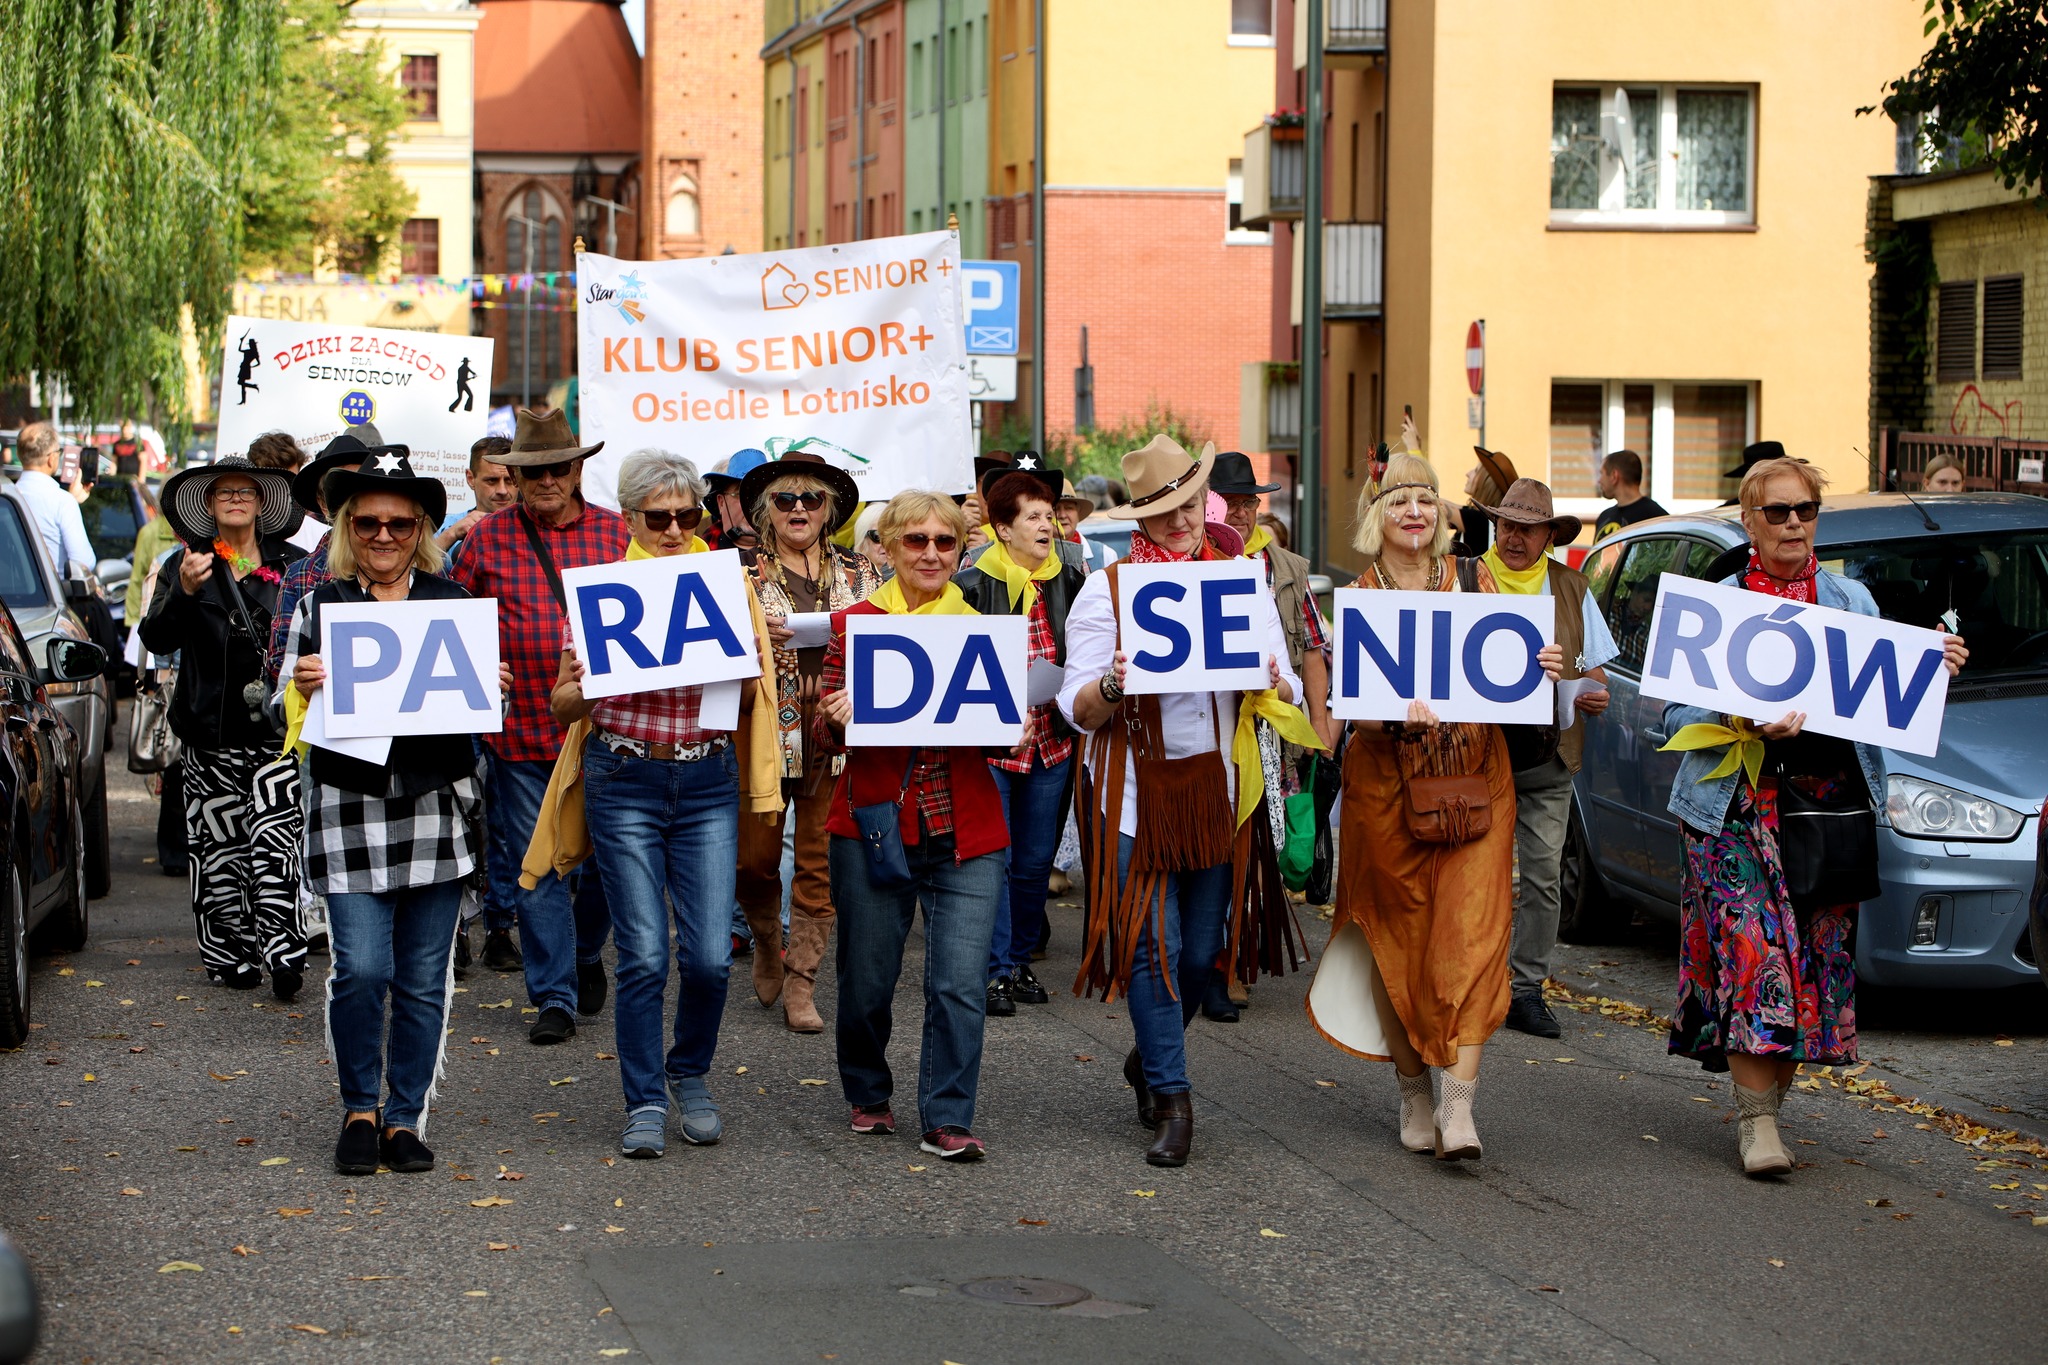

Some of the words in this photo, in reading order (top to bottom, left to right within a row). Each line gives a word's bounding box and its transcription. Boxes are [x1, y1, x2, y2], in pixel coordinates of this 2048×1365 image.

[814, 258, 929, 298] SENIOR
[960, 269, 1003, 326] P
[235, 295, 329, 321] LERIA
[273, 336, 342, 371] DZIKI
[349, 336, 446, 381] ZACHÓD
[351, 356, 373, 366] DLA
[603, 335, 721, 374] KLUB
[736, 321, 934, 375] SENIOR+
[308, 365, 412, 387] SENIORÓW
[632, 388, 769, 423] Osiedle
[783, 374, 931, 416] Lotnisko
[295, 431, 338, 447] steśmy
[411, 450, 440, 460] wytaj
[443, 450, 468, 460] lasso
[443, 464, 467, 473] koni
[576, 572, 746, 675] RA
[1132, 578, 1260, 672] SE
[331, 620, 490, 714] PA
[853, 634, 1021, 724] DA
[1342, 608, 1544, 702] NIO
[1650, 591, 1943, 730] RÓW
